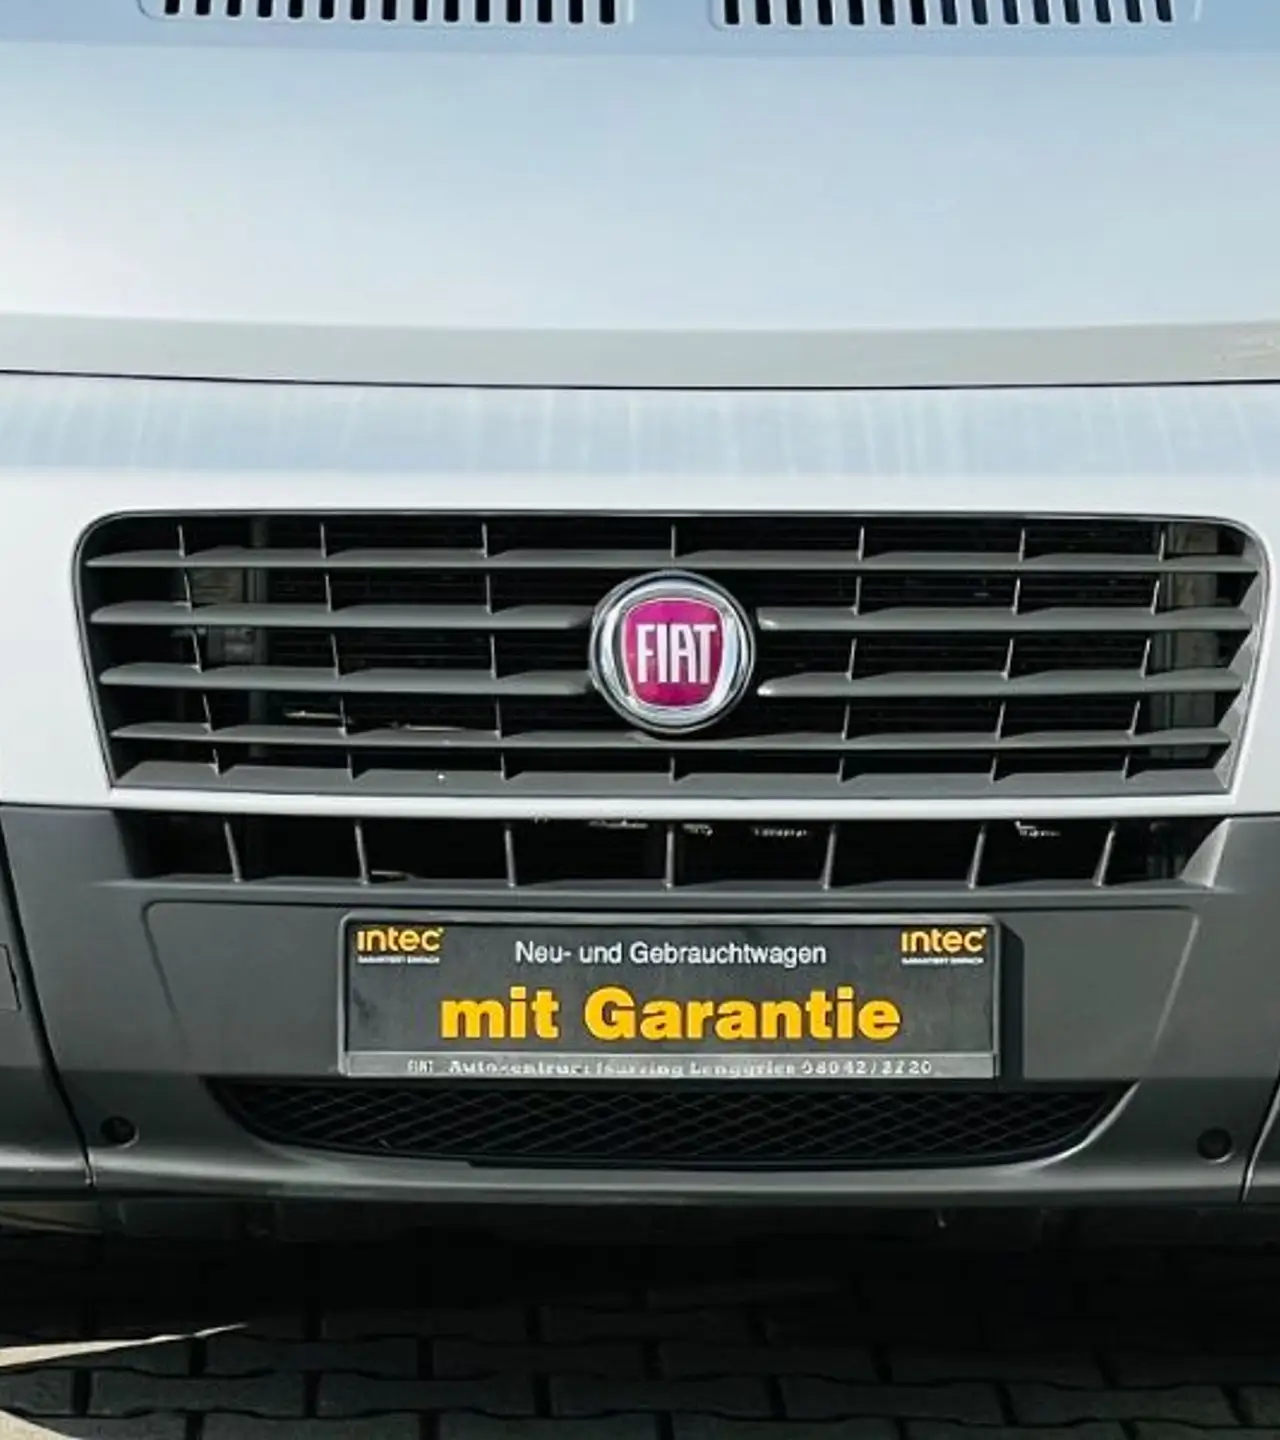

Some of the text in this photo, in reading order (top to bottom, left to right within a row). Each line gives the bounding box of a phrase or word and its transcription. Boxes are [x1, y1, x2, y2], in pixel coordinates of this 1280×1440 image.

[635, 623, 718, 685] FIAT
[357, 927, 442, 952] intec
[901, 927, 984, 953] intec
[515, 940, 827, 969] Neu- und Gebrauchtwagen
[441, 985, 901, 1041] mit Garantie
